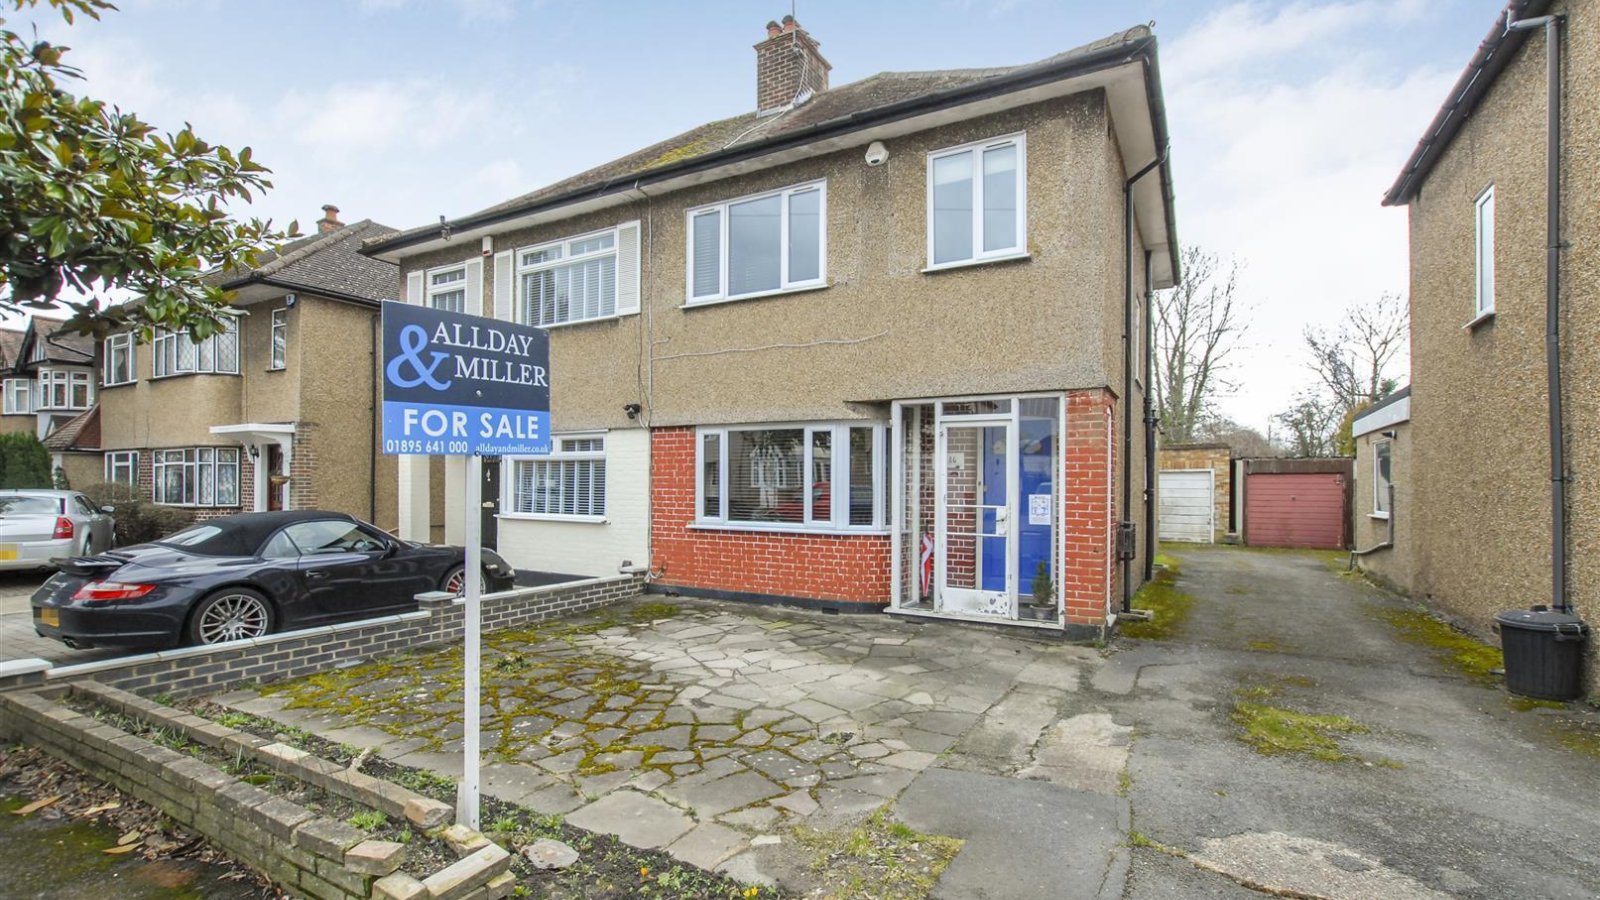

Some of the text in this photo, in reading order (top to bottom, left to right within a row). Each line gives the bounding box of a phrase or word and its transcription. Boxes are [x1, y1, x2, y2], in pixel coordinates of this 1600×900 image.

[430, 321, 533, 357] ALLDAY
[386, 324, 548, 391] & MILLER
[404, 408, 538, 439] FOR SALE
[386, 440, 468, 453] 01895 641 000
[475, 443, 549, 454] alldayandmiller.co.uk
